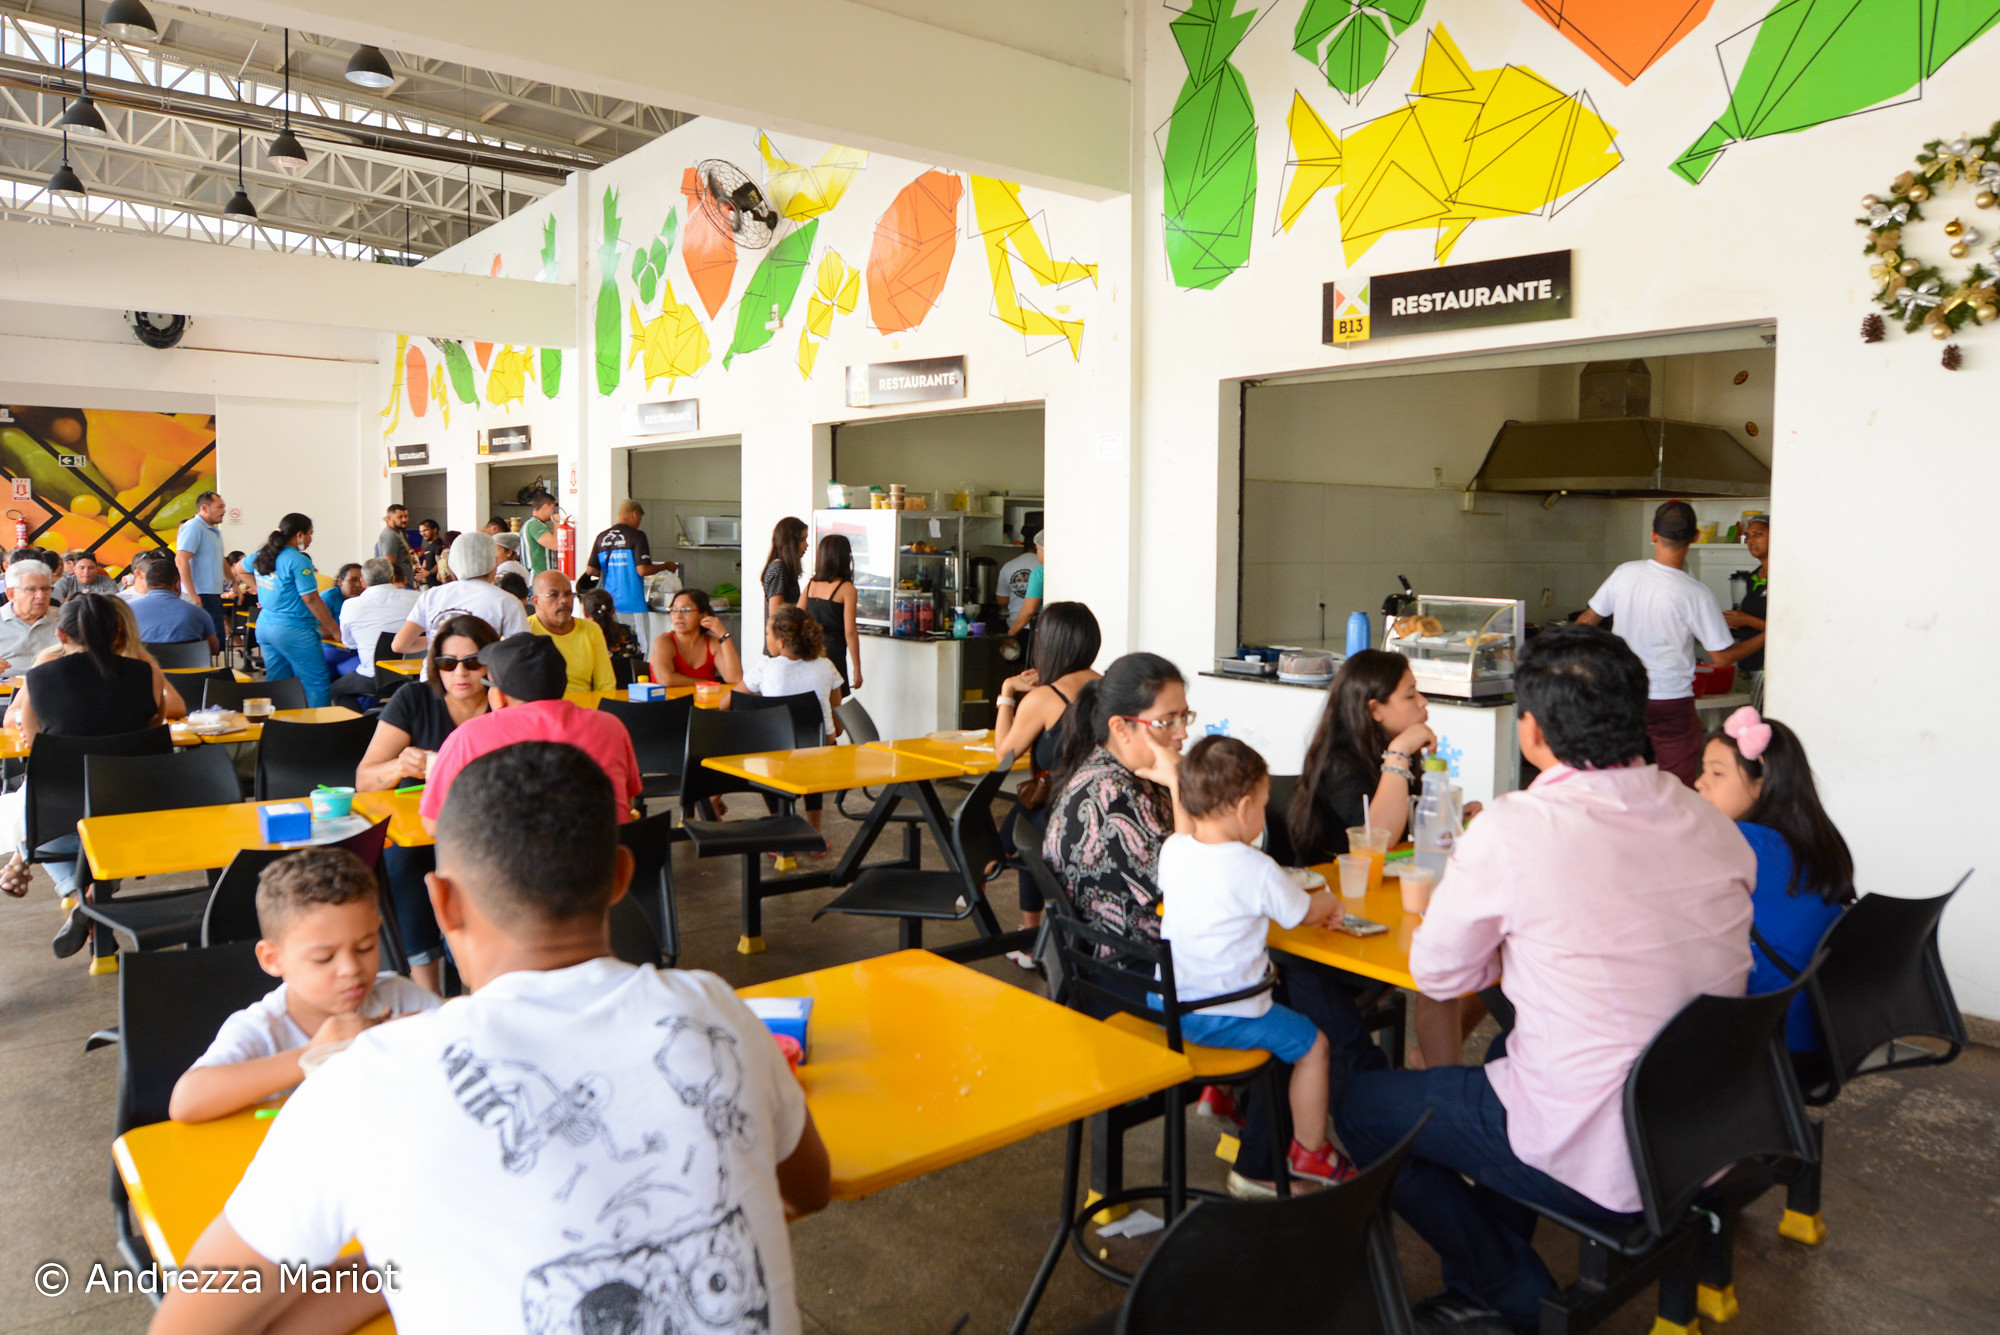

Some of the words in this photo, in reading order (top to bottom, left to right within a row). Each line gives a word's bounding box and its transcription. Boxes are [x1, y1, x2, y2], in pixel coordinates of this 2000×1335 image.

[1391, 279, 1552, 316] RESTAURANTE
[1339, 319, 1363, 334] B13
[879, 372, 956, 391] RESTAURANTE
